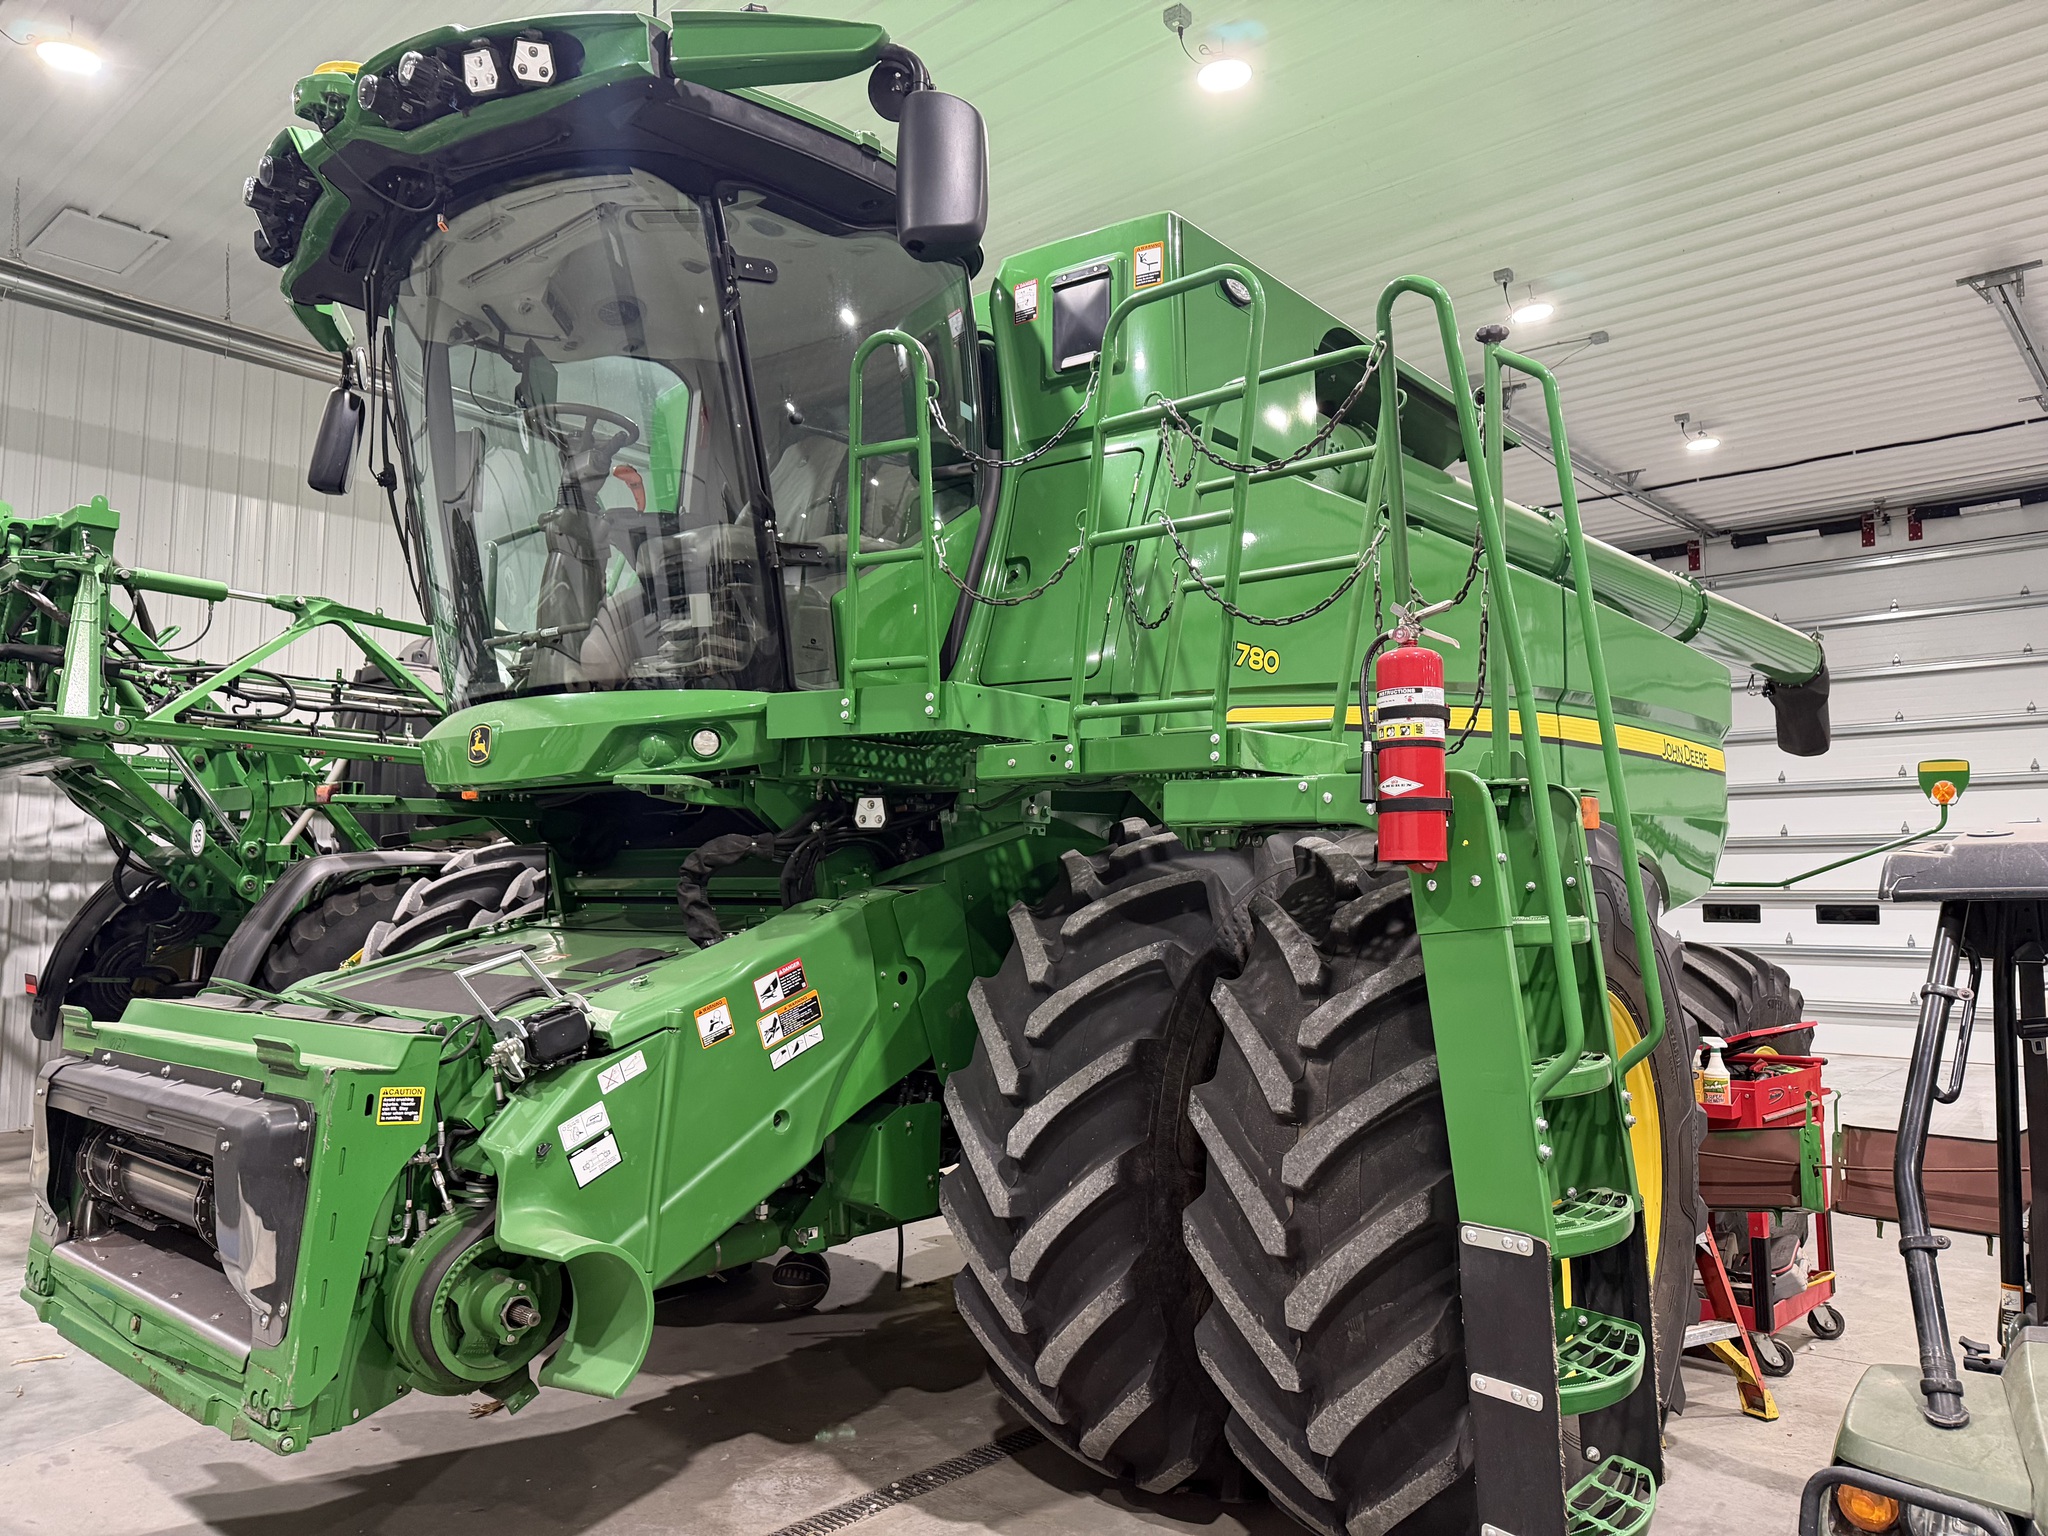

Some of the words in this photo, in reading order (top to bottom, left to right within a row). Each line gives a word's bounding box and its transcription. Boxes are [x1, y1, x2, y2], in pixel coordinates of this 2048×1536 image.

[1231, 641, 1280, 674] 780
[1662, 738, 1684, 762] JOHN
[1684, 744, 1709, 767] DEERE
[194, 829, 202, 843] 35
[781, 961, 800, 973] DANGER
[702, 1000, 723, 1012] WARNING
[788, 995, 808, 1008] WARNING
